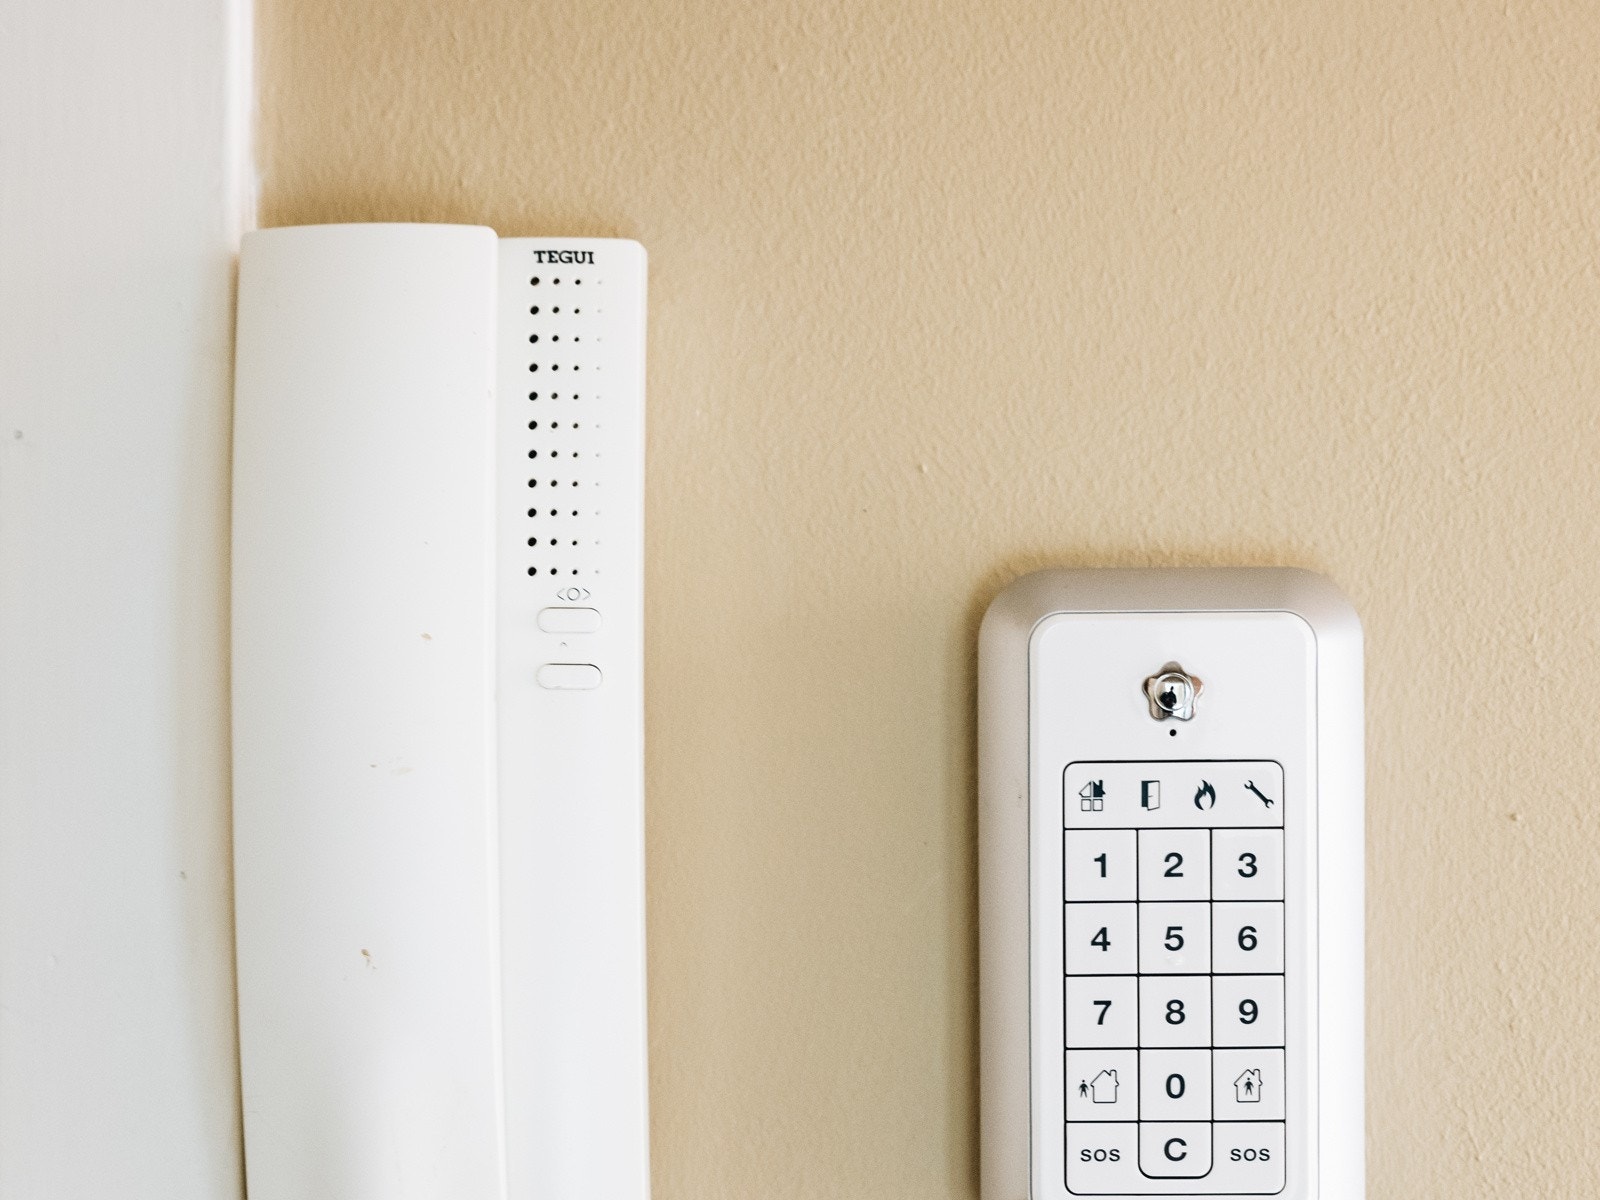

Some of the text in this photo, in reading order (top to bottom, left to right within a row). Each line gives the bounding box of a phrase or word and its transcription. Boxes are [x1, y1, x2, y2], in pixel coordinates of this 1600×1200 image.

[533, 250, 596, 265] TEGUI
[1093, 852, 1107, 878] 1
[1163, 852, 1184, 878] 2
[1237, 852, 1258, 879] 3
[1090, 926, 1111, 952] 4
[1164, 926, 1185, 952] 5
[1237, 925, 1258, 952] 6
[1093, 1000, 1112, 1026] 7
[1165, 999, 1186, 1025] 8
[1238, 998, 1259, 1025] 9
[1165, 1073, 1186, 1100] 0
[1163, 1137, 1187, 1162] C
